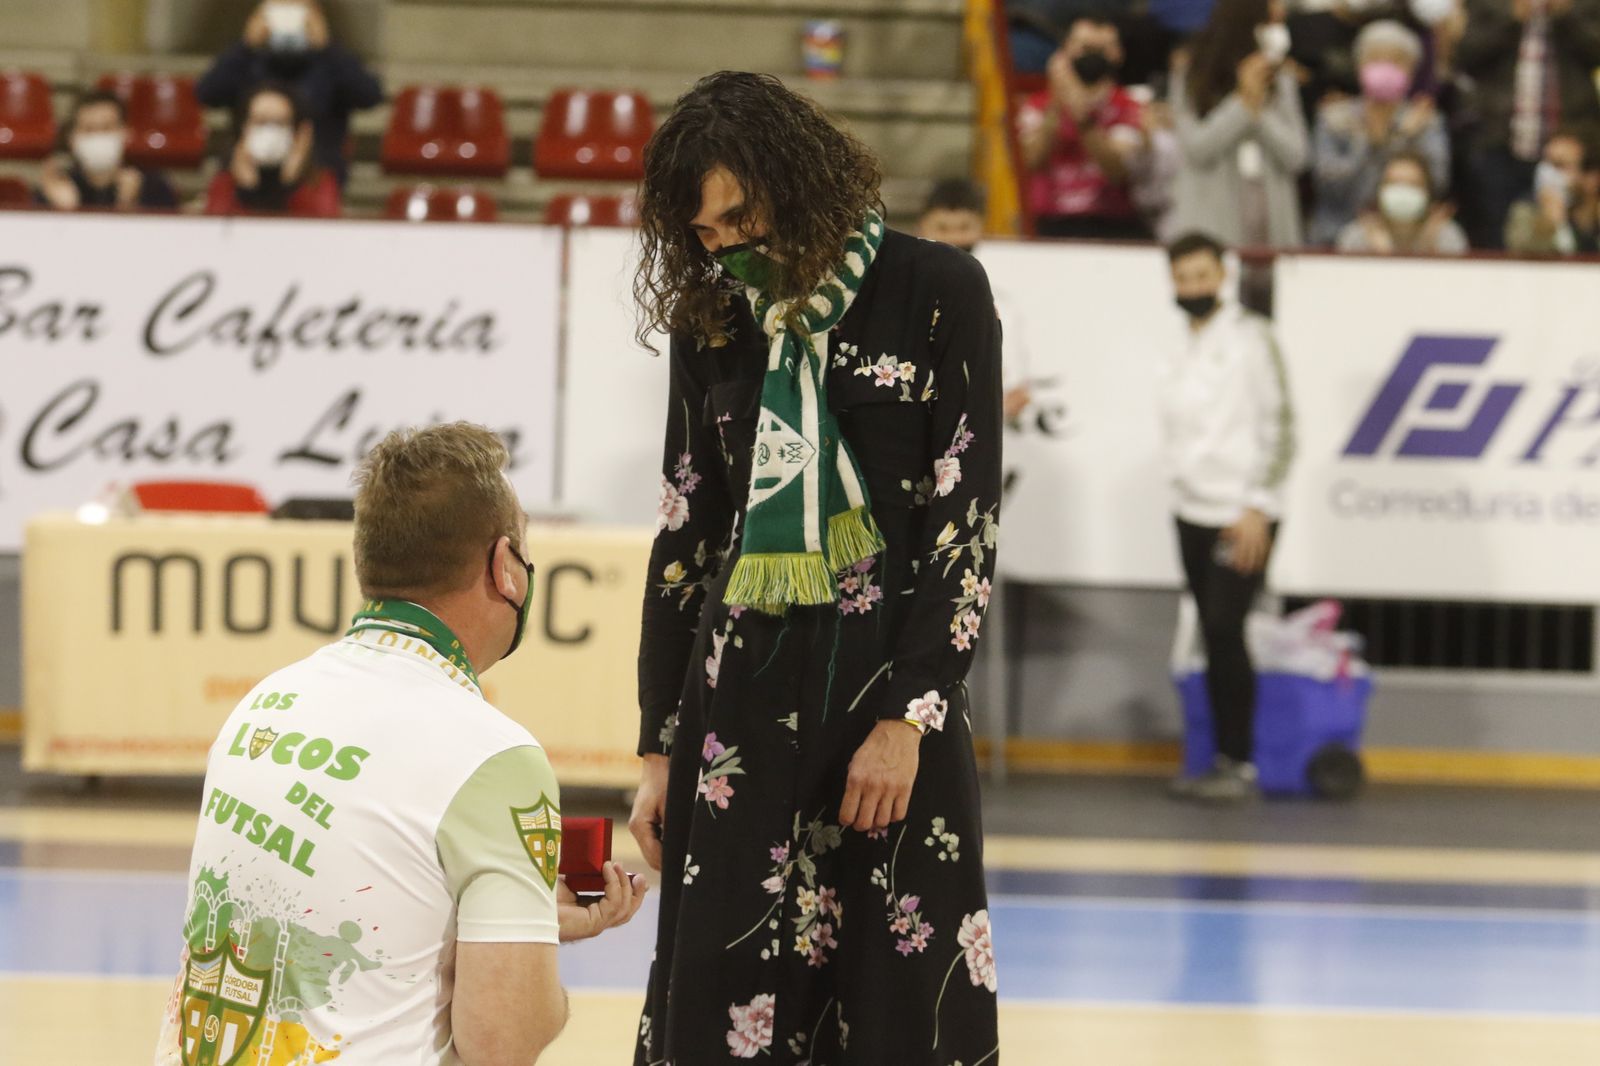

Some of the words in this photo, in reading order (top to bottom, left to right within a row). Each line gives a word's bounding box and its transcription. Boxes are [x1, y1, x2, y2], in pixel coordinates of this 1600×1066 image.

[20, 380, 240, 472] Casa
[250, 692, 298, 711] LOS
[285, 781, 335, 830] DEL
[204, 787, 316, 878] FUTSAL
[224, 986, 252, 1002] FUTSAL
